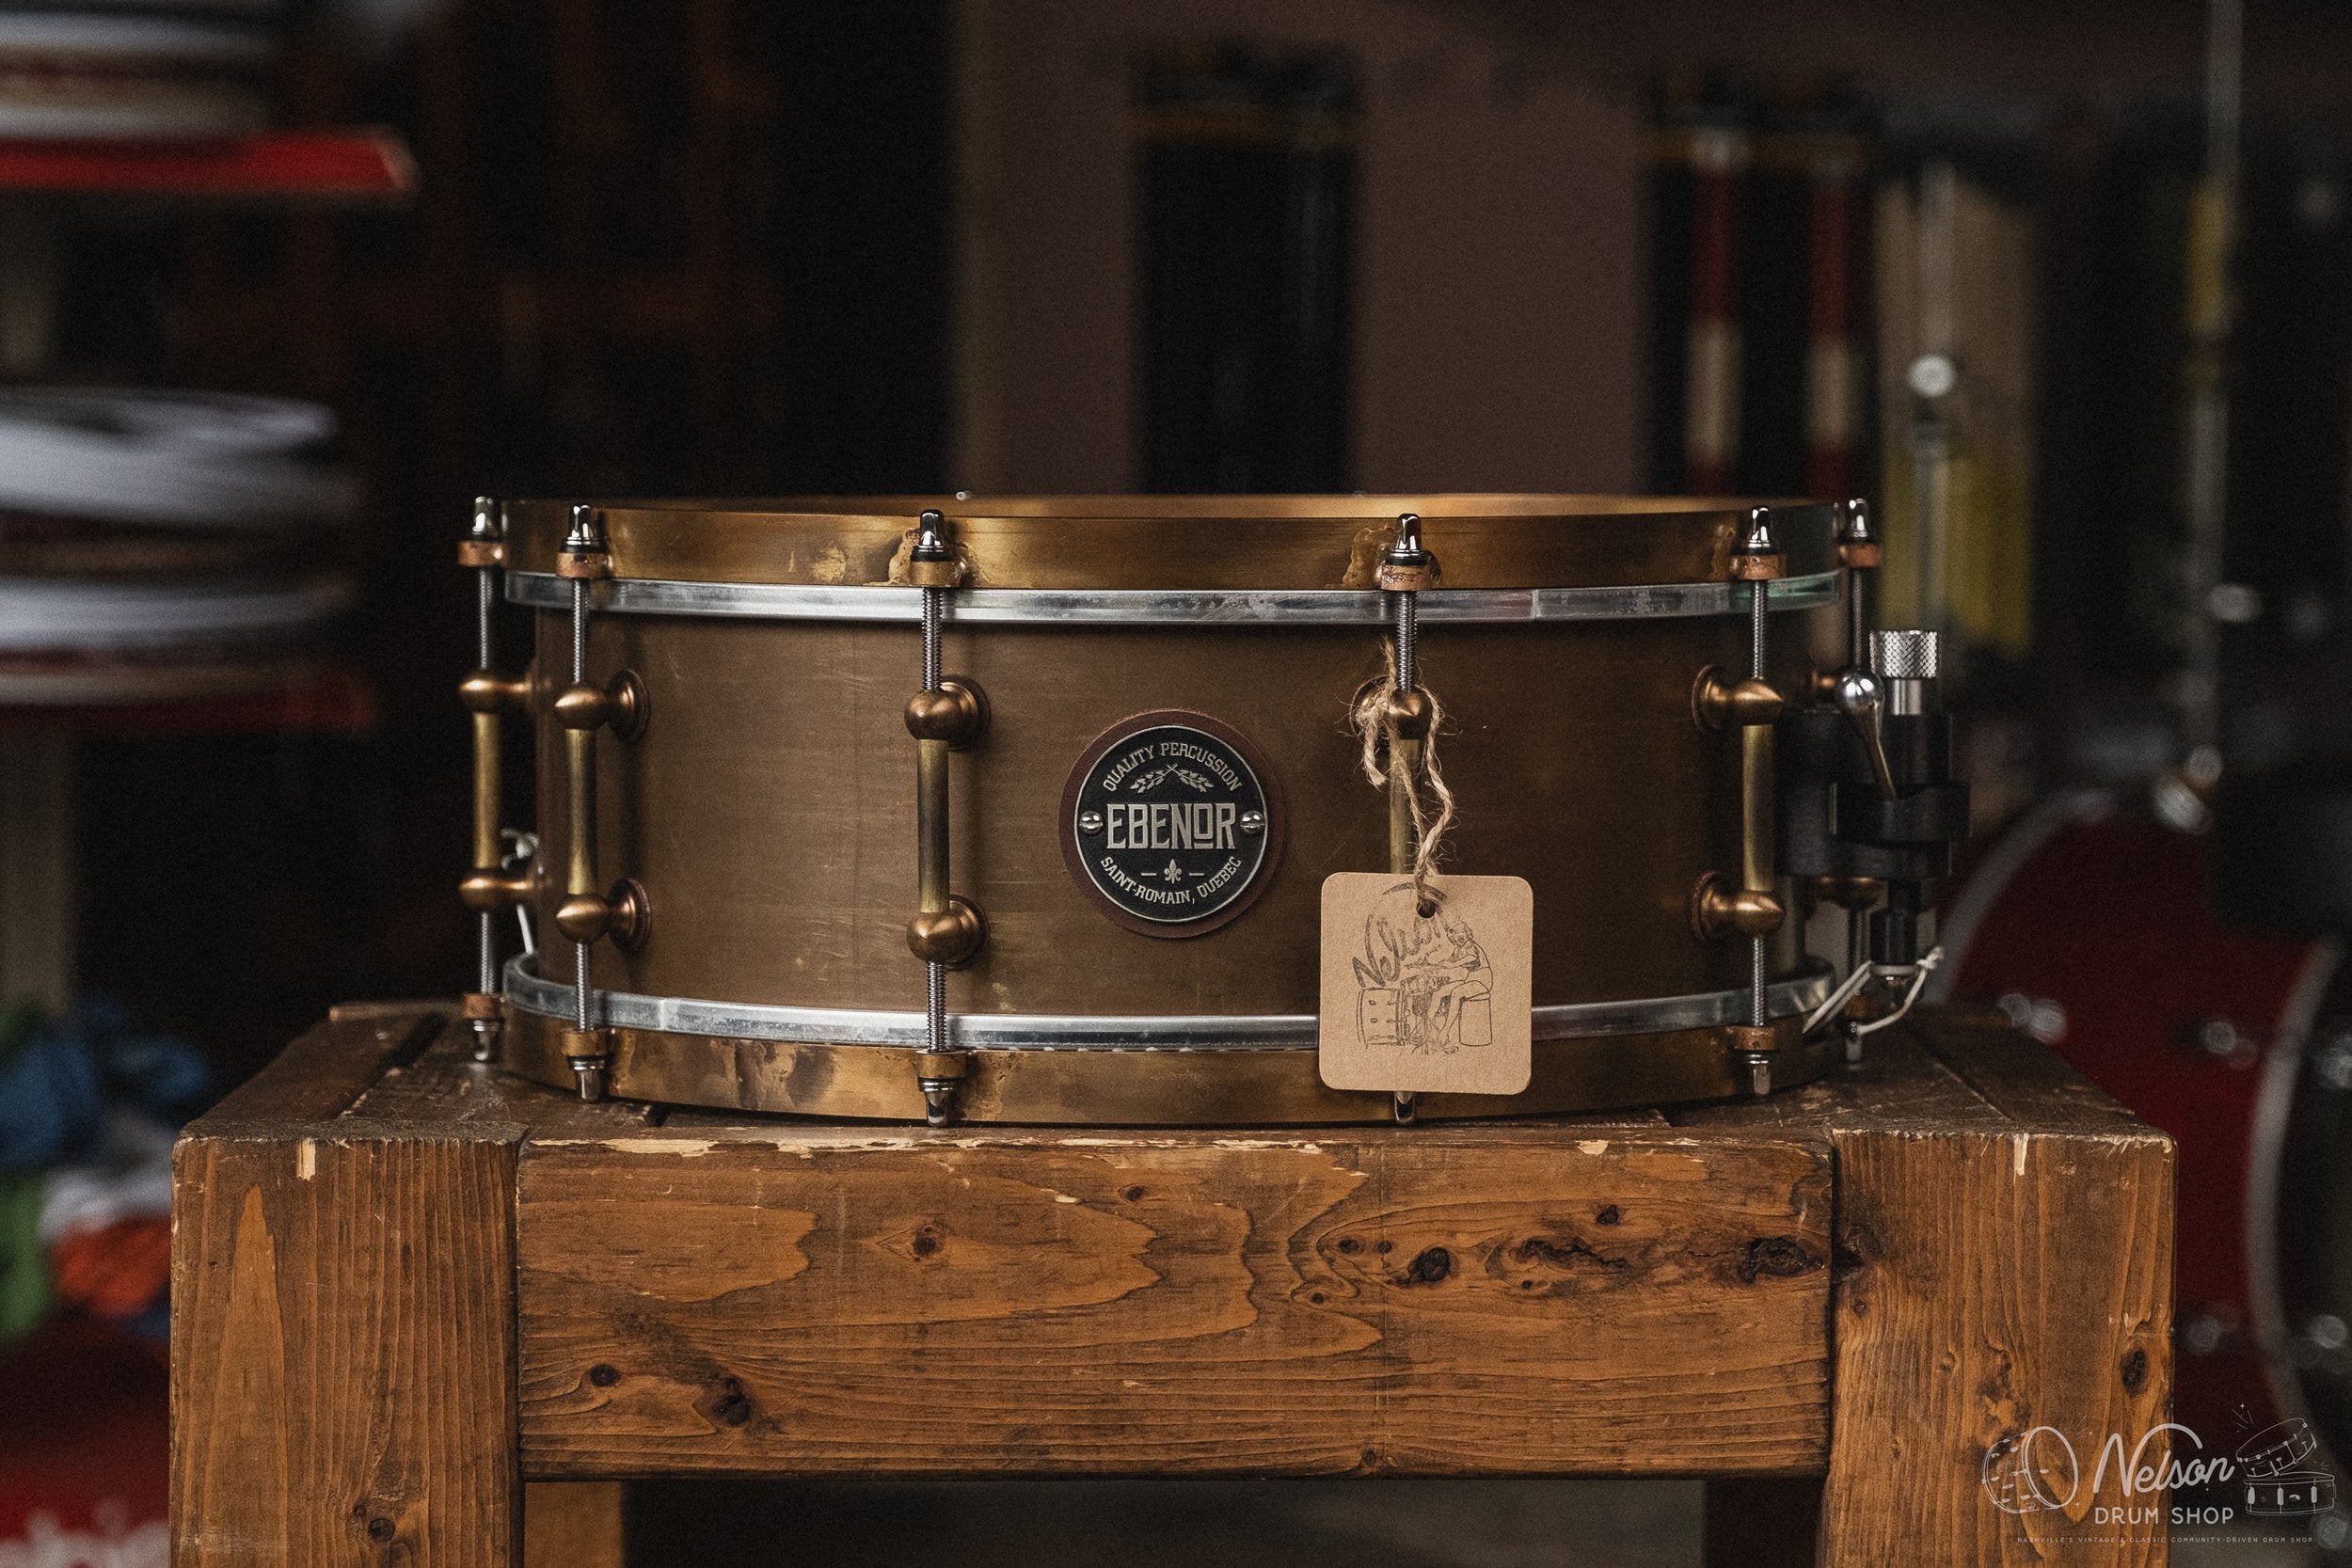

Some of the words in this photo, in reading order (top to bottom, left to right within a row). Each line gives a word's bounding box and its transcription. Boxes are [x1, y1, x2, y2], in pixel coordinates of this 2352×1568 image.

[1103, 746, 1155, 792] QUALITY
[1160, 742, 1242, 792] PERCUSSION
[1106, 802, 1236, 849] EBENOR
[1101, 856, 1196, 905] SAINT-ROMAIN,
[1197, 856, 1242, 898] QUEBEC
